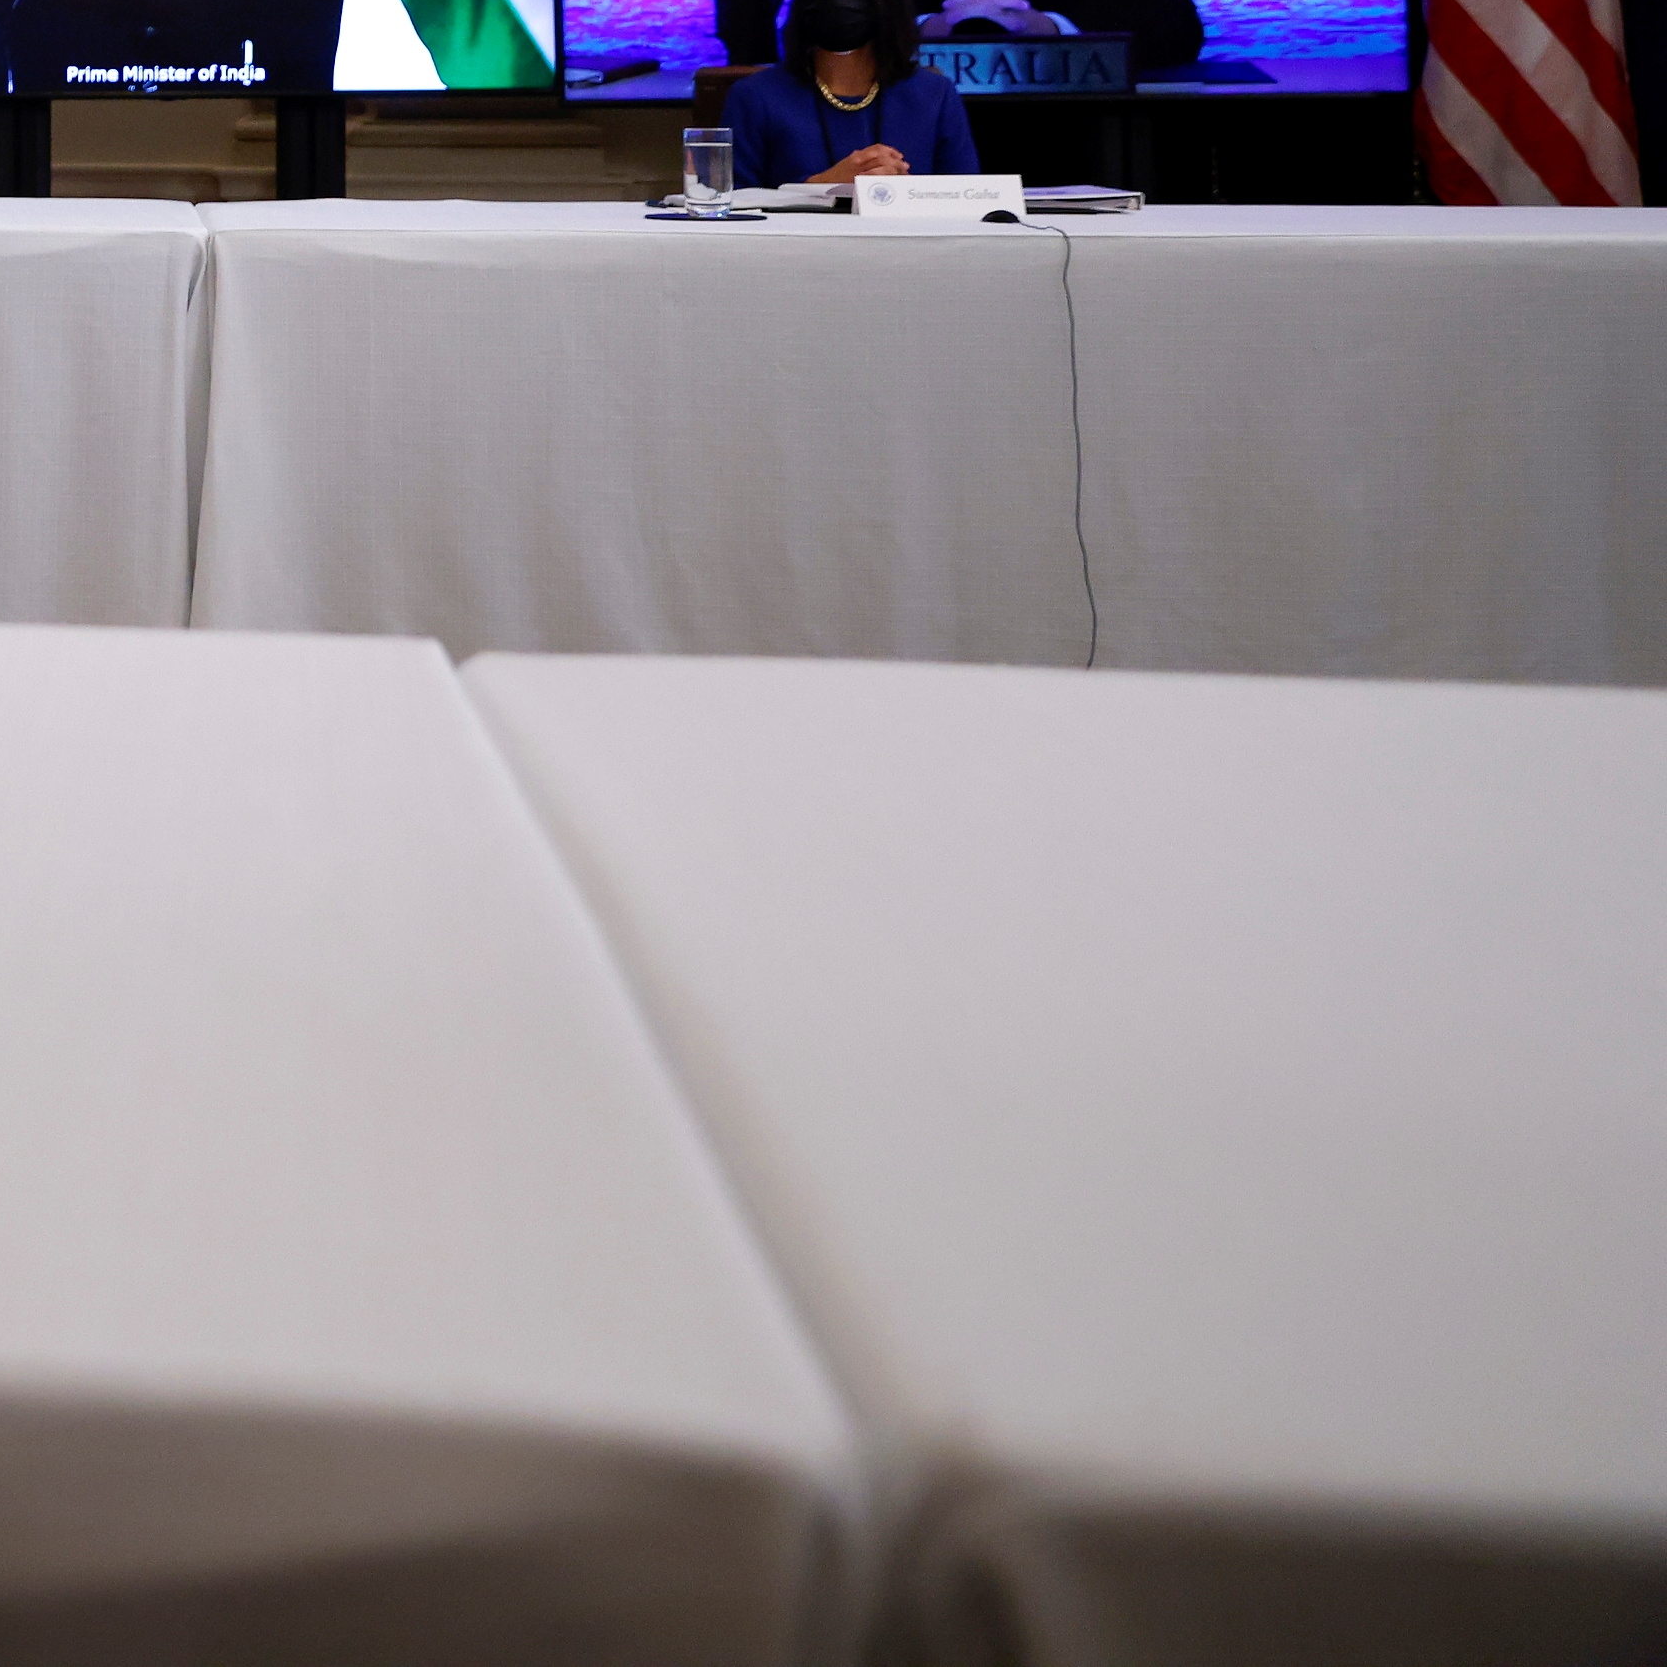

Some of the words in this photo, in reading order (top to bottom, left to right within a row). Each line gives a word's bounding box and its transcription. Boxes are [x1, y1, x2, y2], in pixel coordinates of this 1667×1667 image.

[67, 65, 119, 83] Prime
[123, 65, 196, 82] Minister
[198, 64, 218, 82] of
[220, 64, 266, 82] India
[920, 51, 1113, 85] TRALIA
